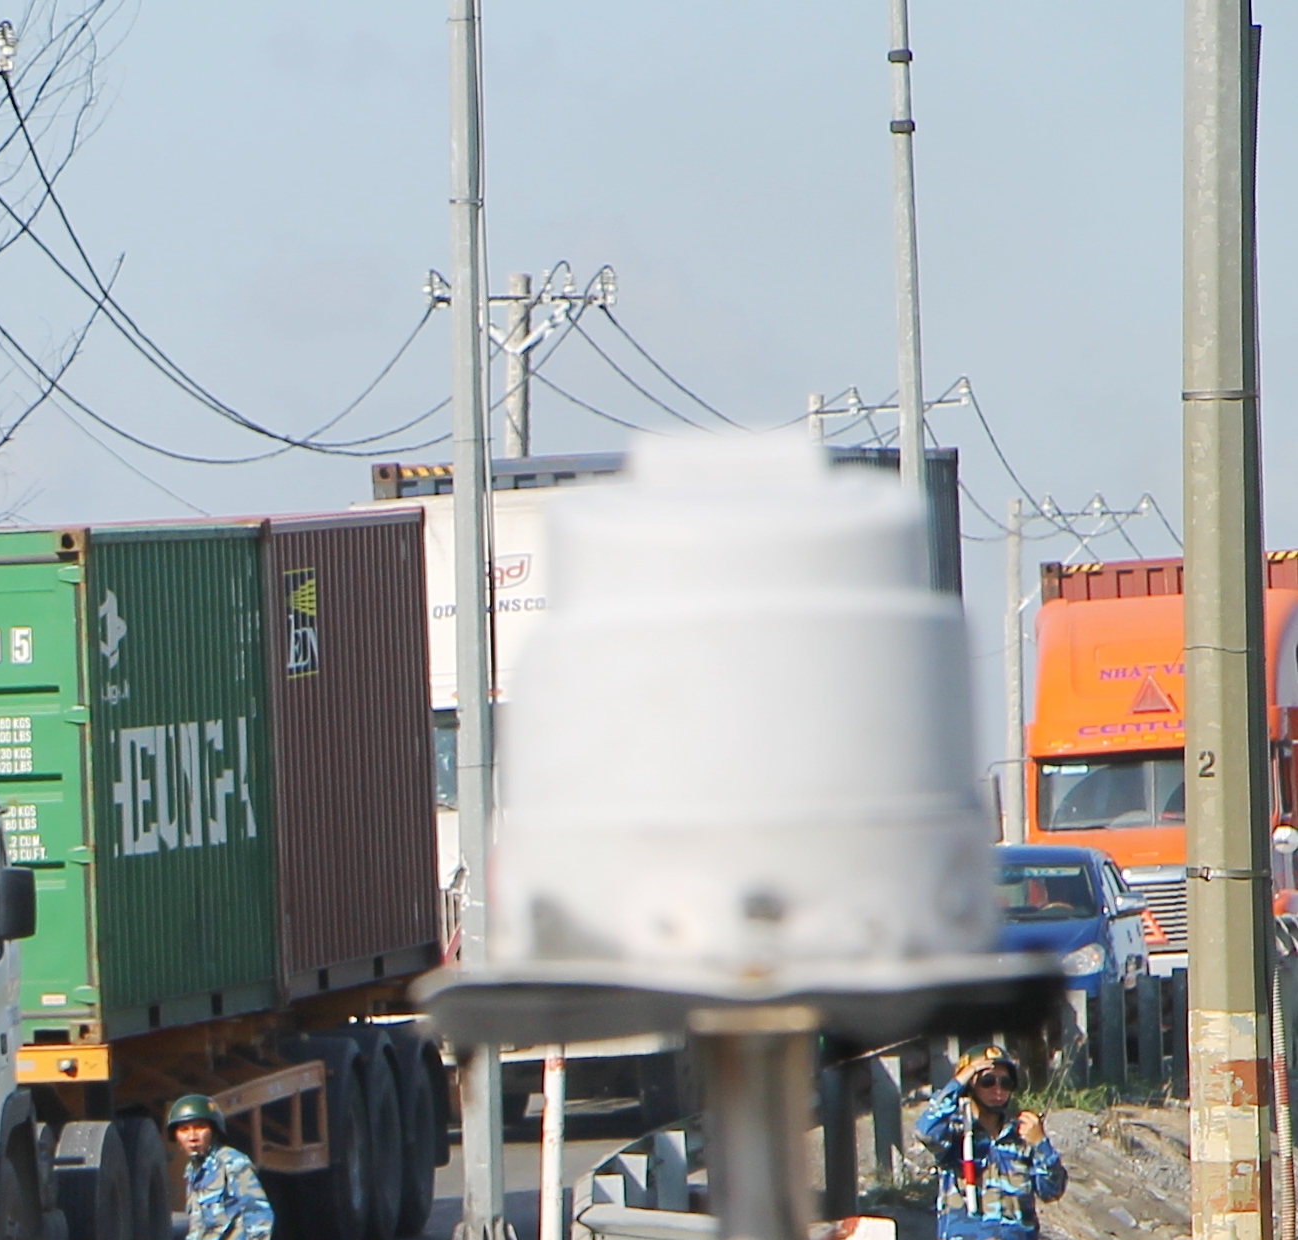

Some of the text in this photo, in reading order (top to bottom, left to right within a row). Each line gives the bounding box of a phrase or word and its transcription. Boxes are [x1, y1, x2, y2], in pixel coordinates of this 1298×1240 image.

[13, 628, 32, 663] 5
[13, 717, 32, 730] KGS
[13, 730, 32, 743] LBS
[13, 747, 32, 760] KGS
[14, 760, 33, 774] LBS
[1198, 751, 1216, 778] 2
